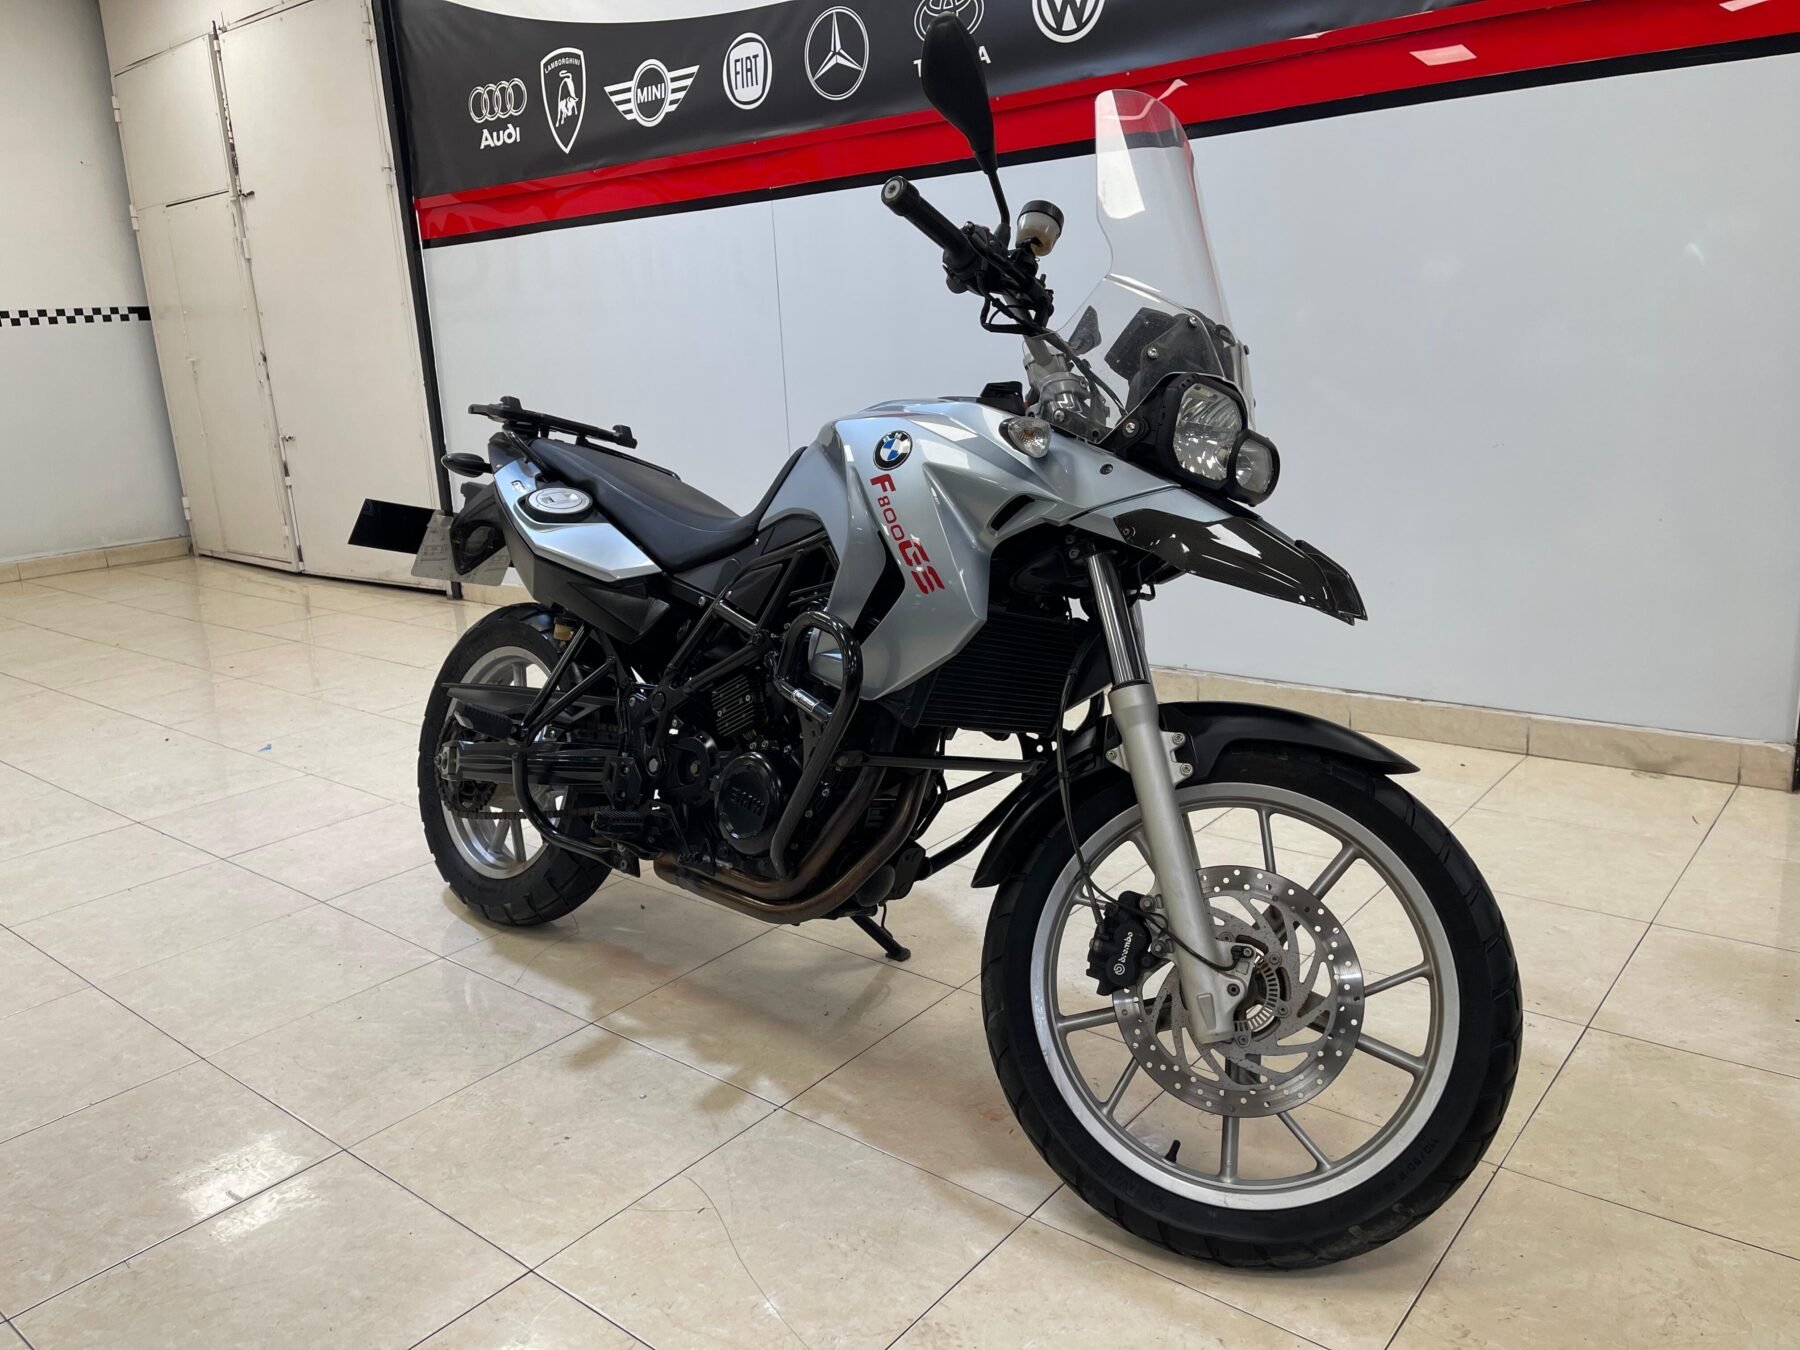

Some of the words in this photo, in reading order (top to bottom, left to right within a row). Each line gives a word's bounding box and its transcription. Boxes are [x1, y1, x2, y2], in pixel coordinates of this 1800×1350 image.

[543, 57, 583, 74] LAMBORGHINI
[733, 53, 760, 91] FIAT
[636, 82, 666, 104] MINI
[479, 122, 521, 149] Audi
[1117, 931, 1135, 964] brembo
